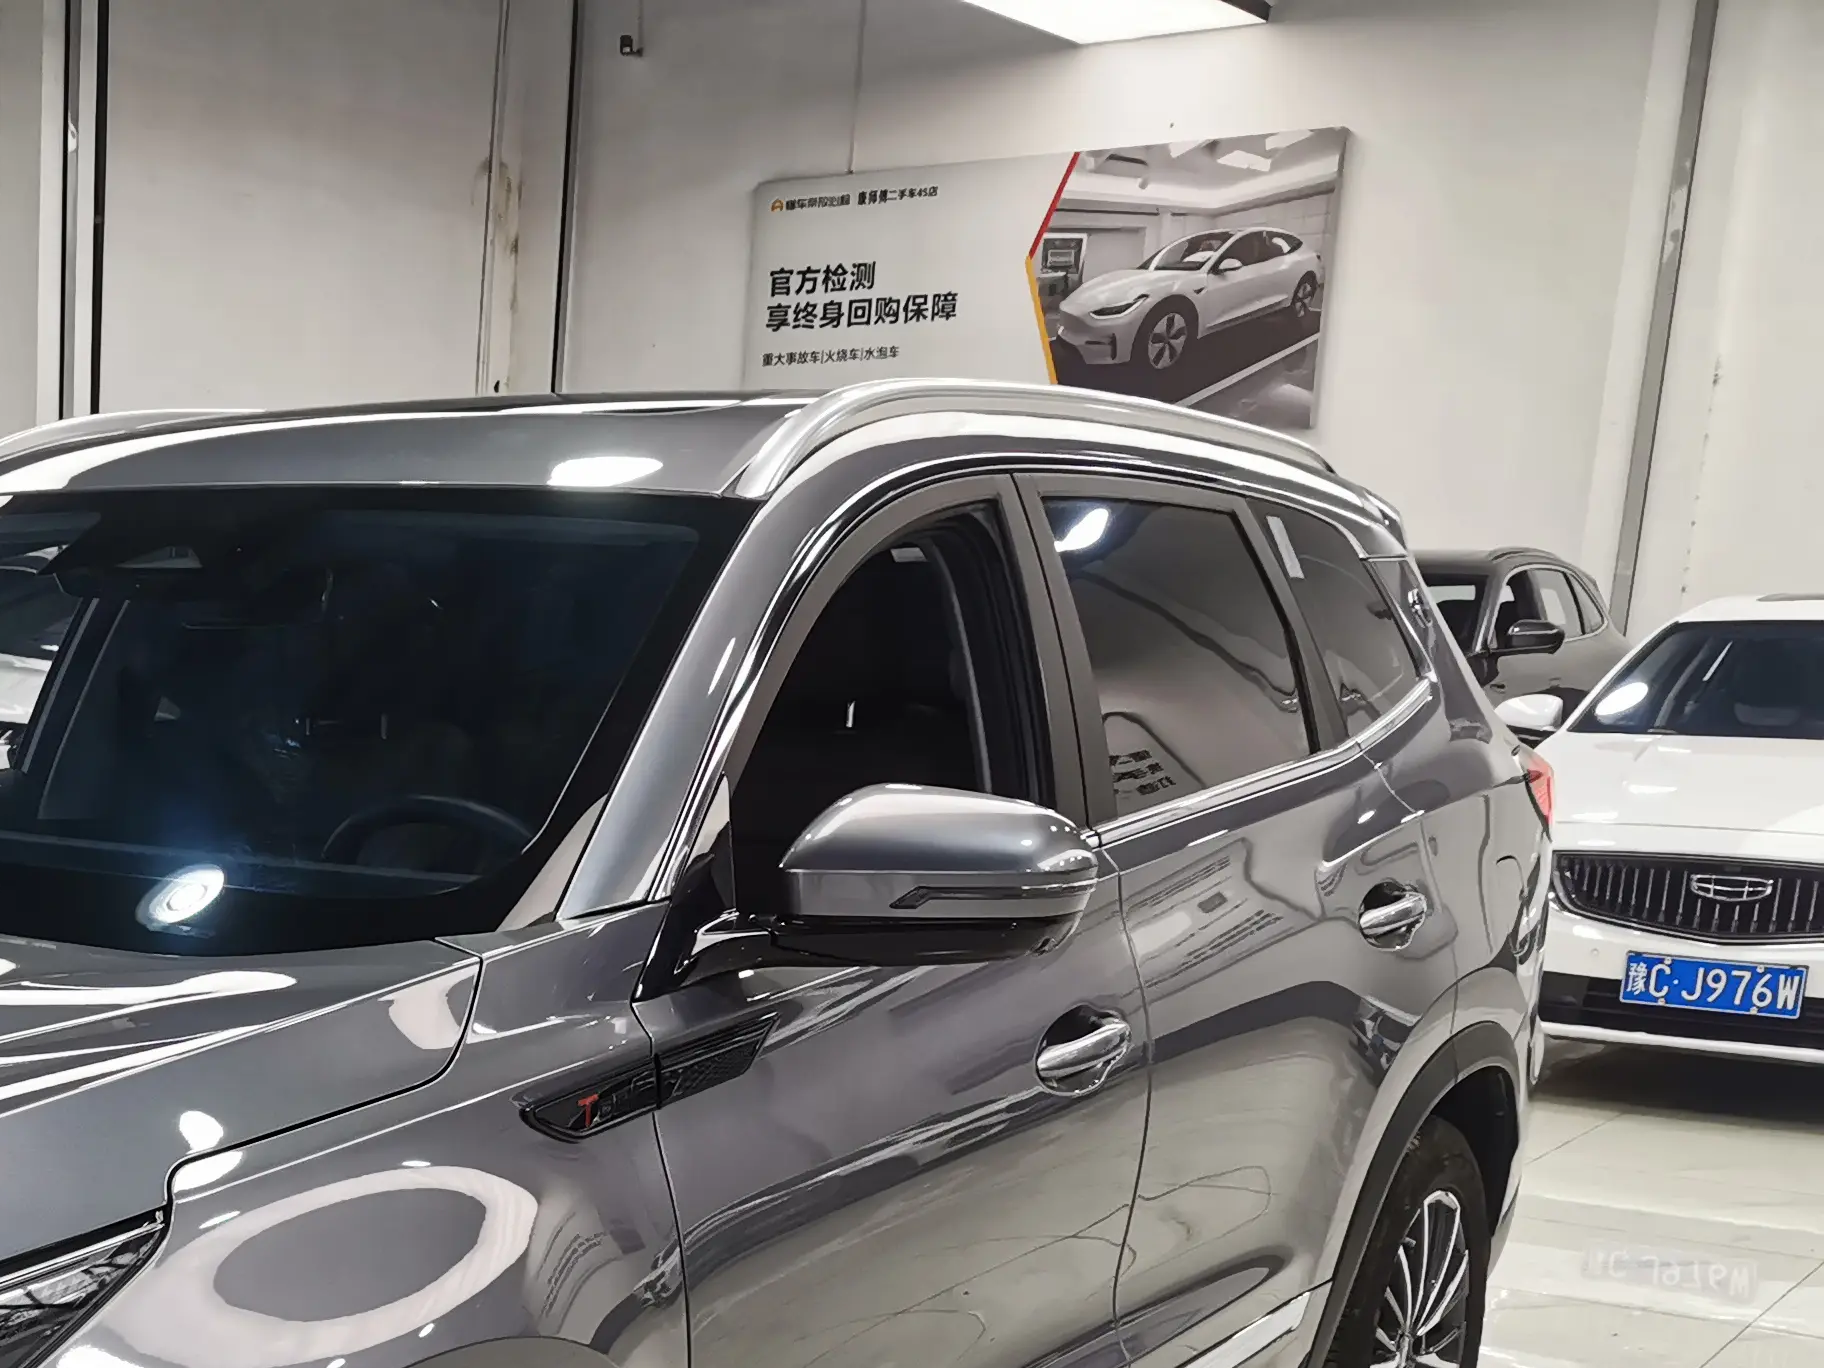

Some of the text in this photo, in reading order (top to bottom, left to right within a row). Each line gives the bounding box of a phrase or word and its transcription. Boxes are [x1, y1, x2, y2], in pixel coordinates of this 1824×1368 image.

[769, 261, 877, 298] 官方检测
[765, 291, 959, 333] 享终身回购保障
